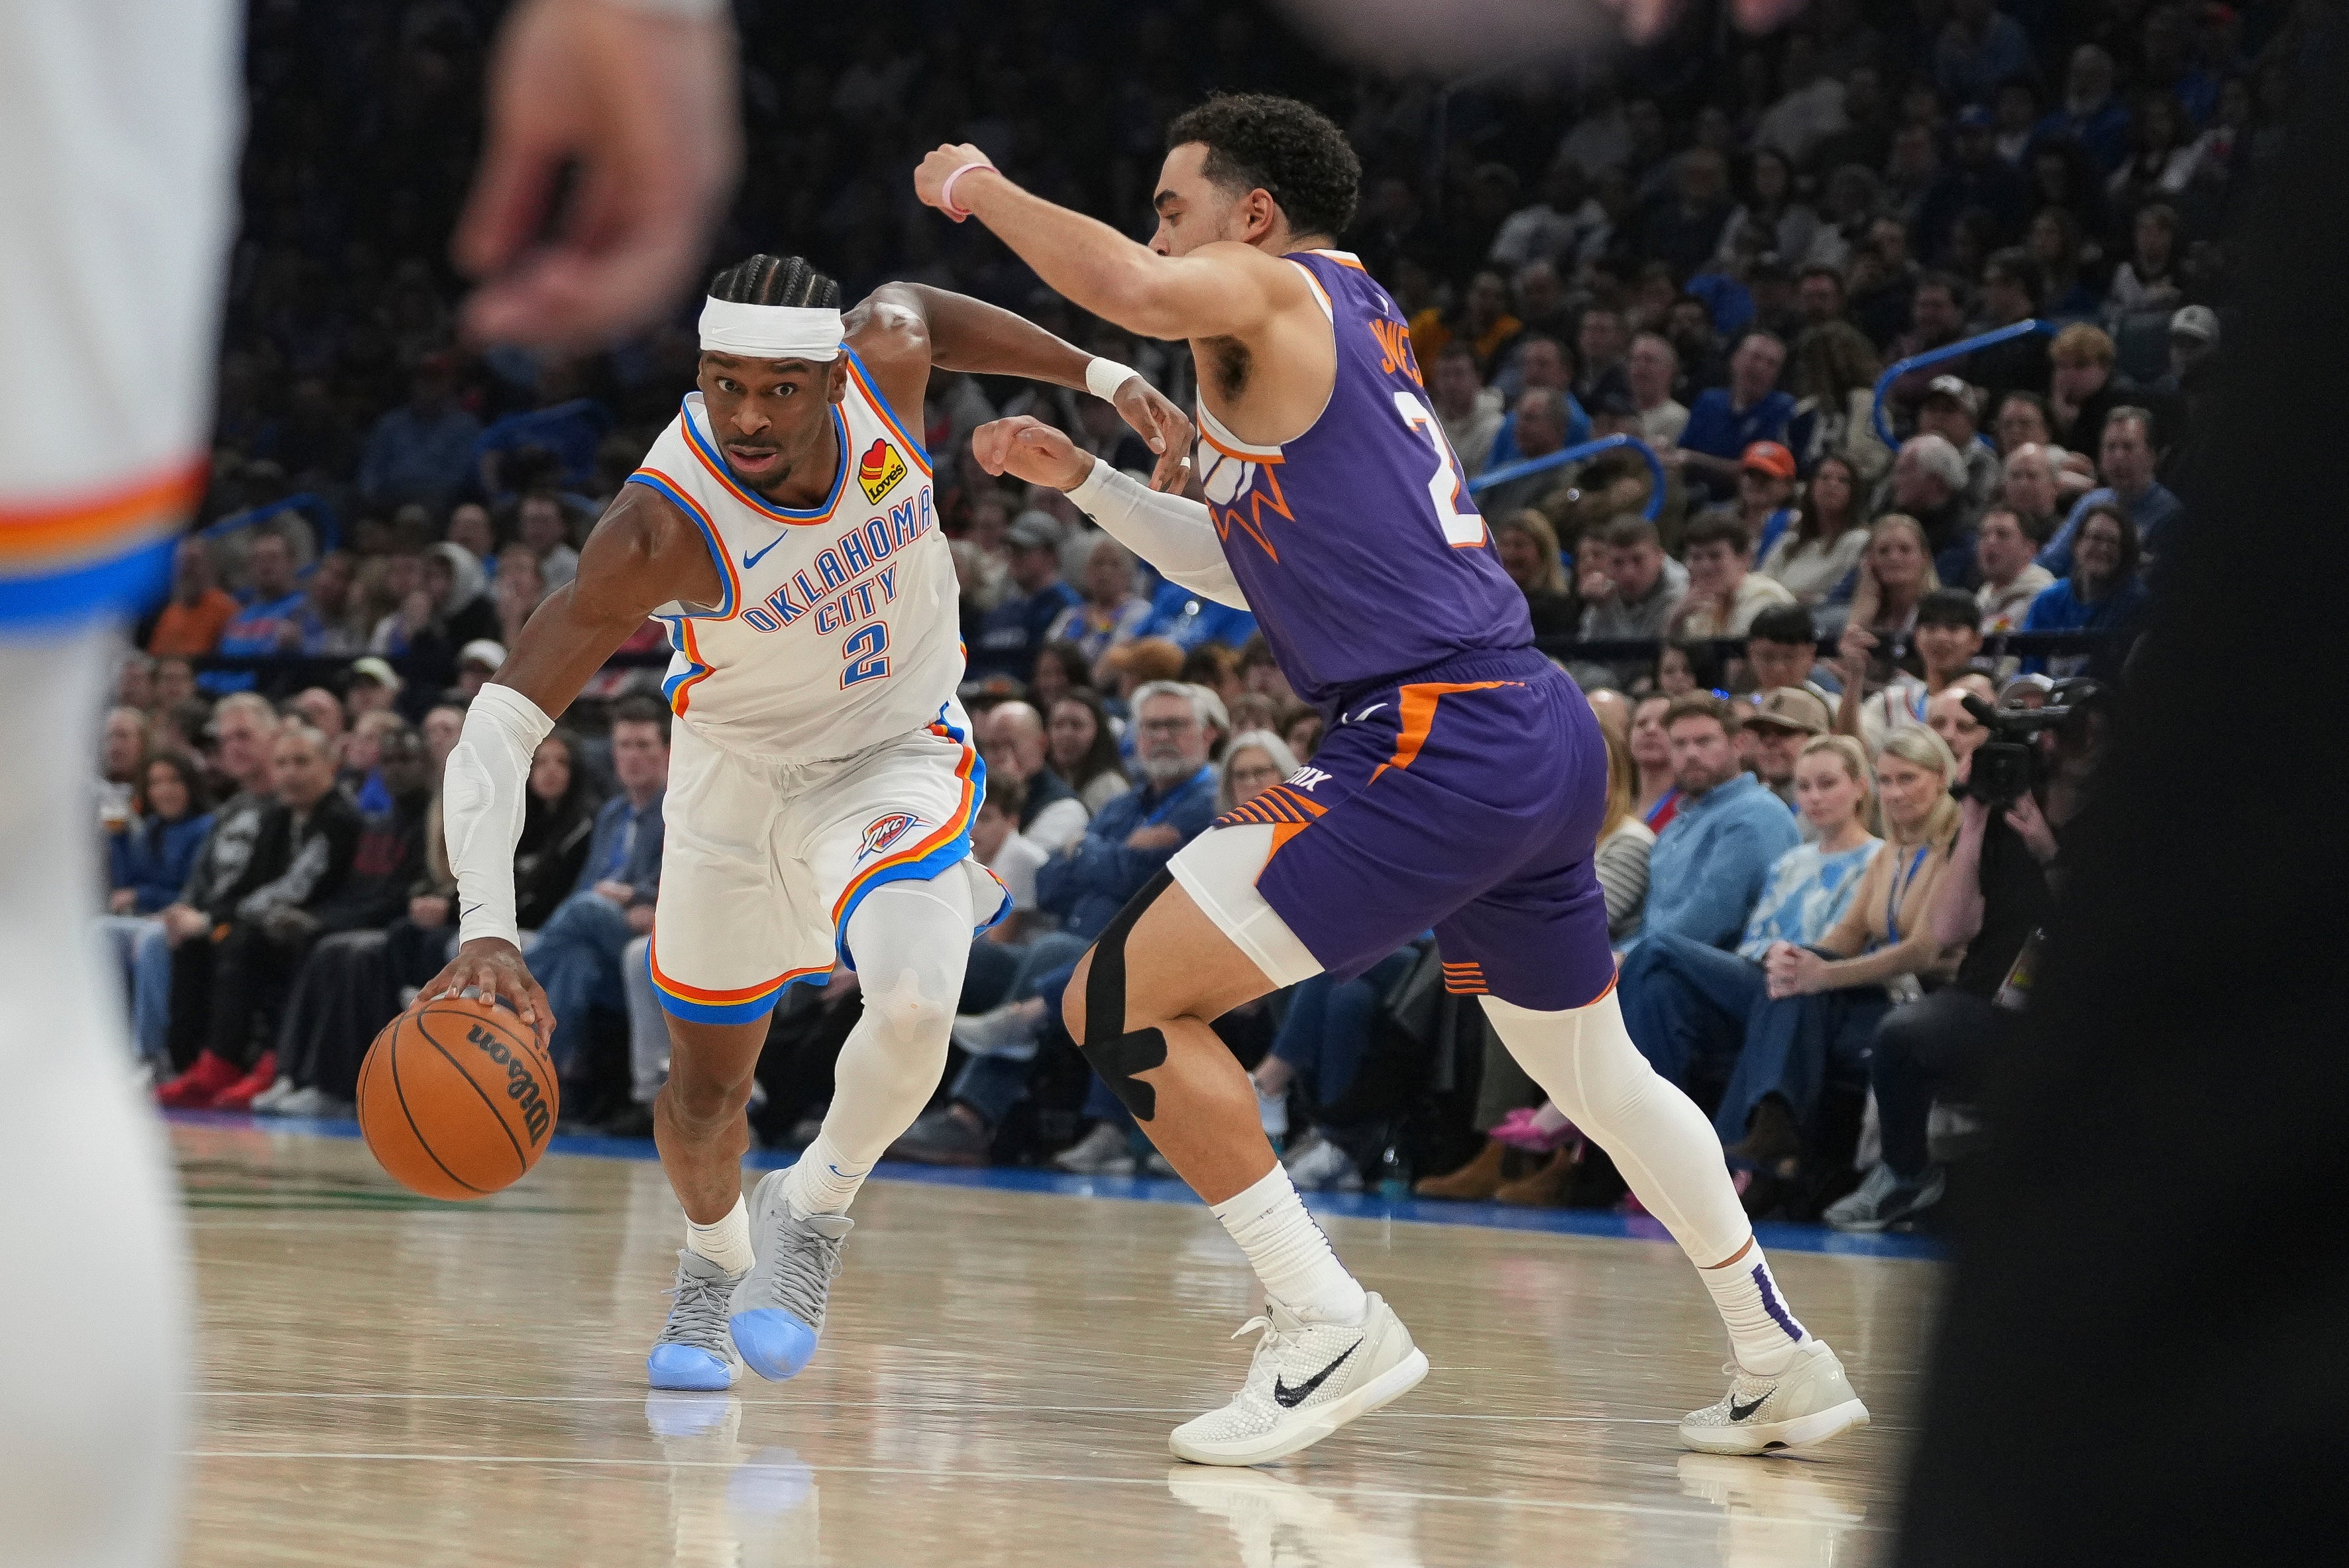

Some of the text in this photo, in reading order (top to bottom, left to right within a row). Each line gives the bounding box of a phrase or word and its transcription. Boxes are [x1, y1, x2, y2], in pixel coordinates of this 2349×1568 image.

[1393, 392, 1490, 549] 2
[740, 485, 932, 633] OKLAHOMA
[814, 561, 898, 635] CITY
[840, 621, 891, 690] 2
[466, 1023, 550, 1147] Wilson
